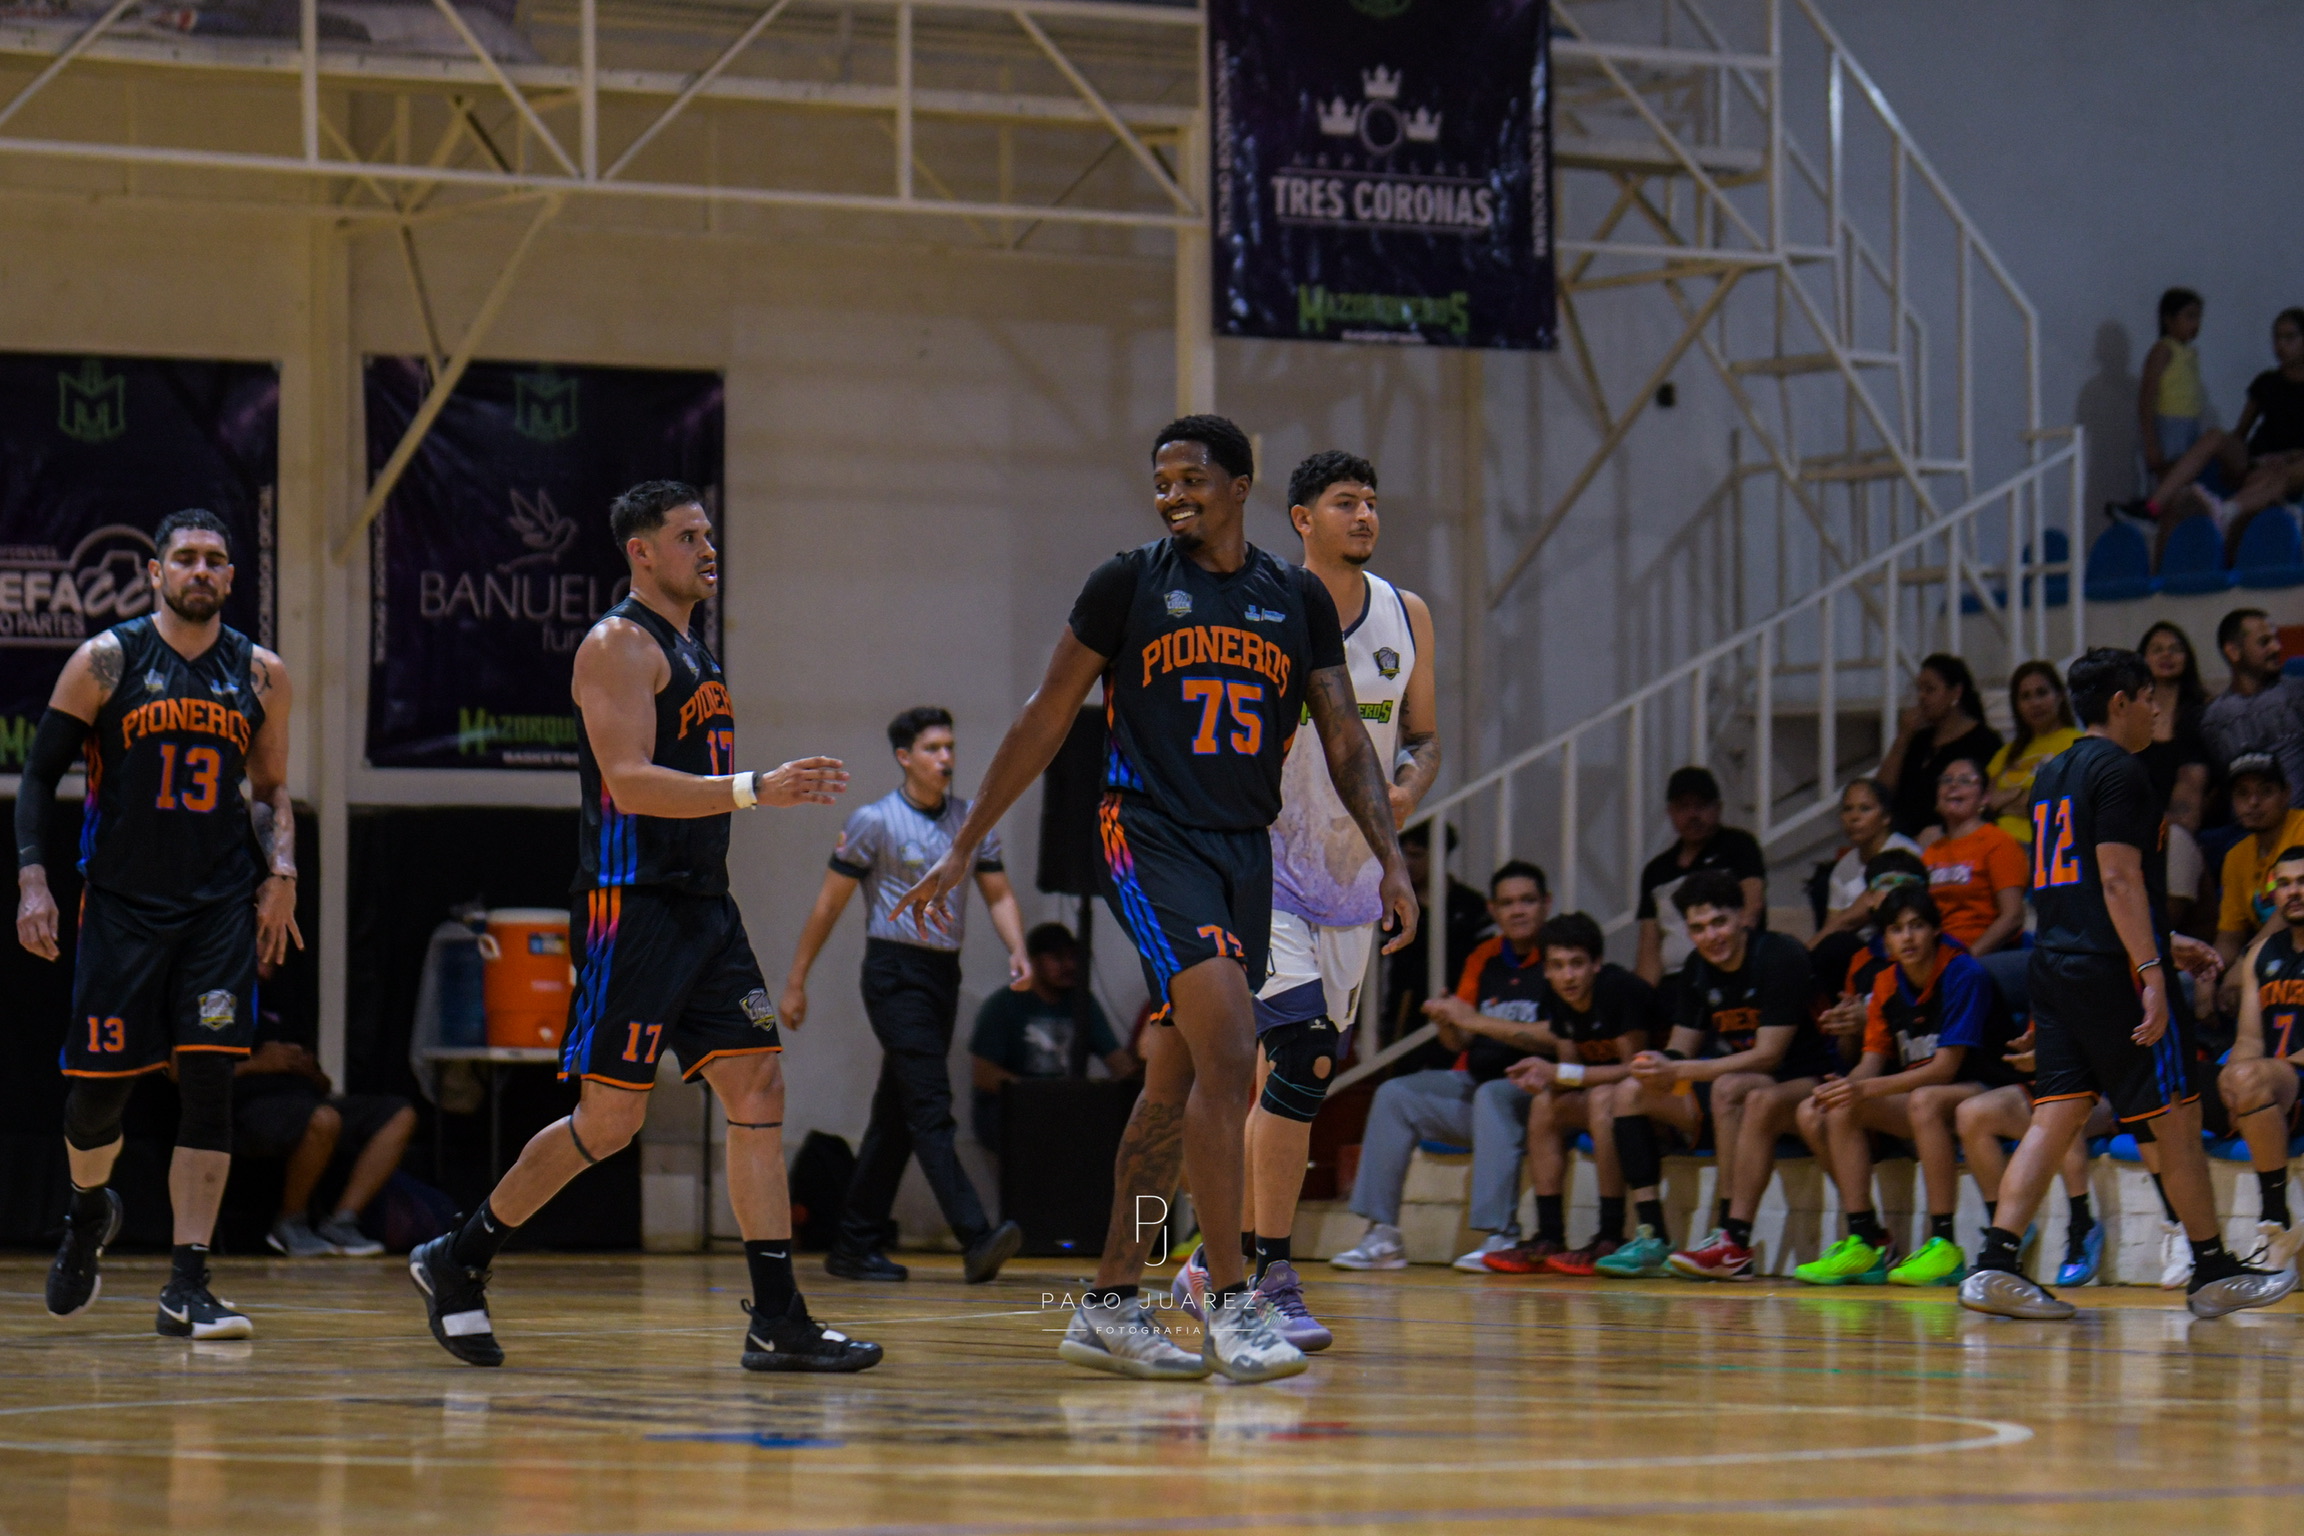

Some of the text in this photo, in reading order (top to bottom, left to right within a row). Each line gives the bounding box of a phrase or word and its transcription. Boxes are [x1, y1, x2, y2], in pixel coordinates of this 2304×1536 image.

[1271, 175, 1494, 227] TRES CORONAS
[1142, 626, 1291, 697] PIONEROS
[1182, 676, 1265, 756] 75
[156, 742, 224, 813] 13
[2033, 795, 2082, 891] 12
[87, 1016, 125, 1052] 13
[621, 1021, 663, 1064] 17
[2273, 1012, 2297, 1058] 7
